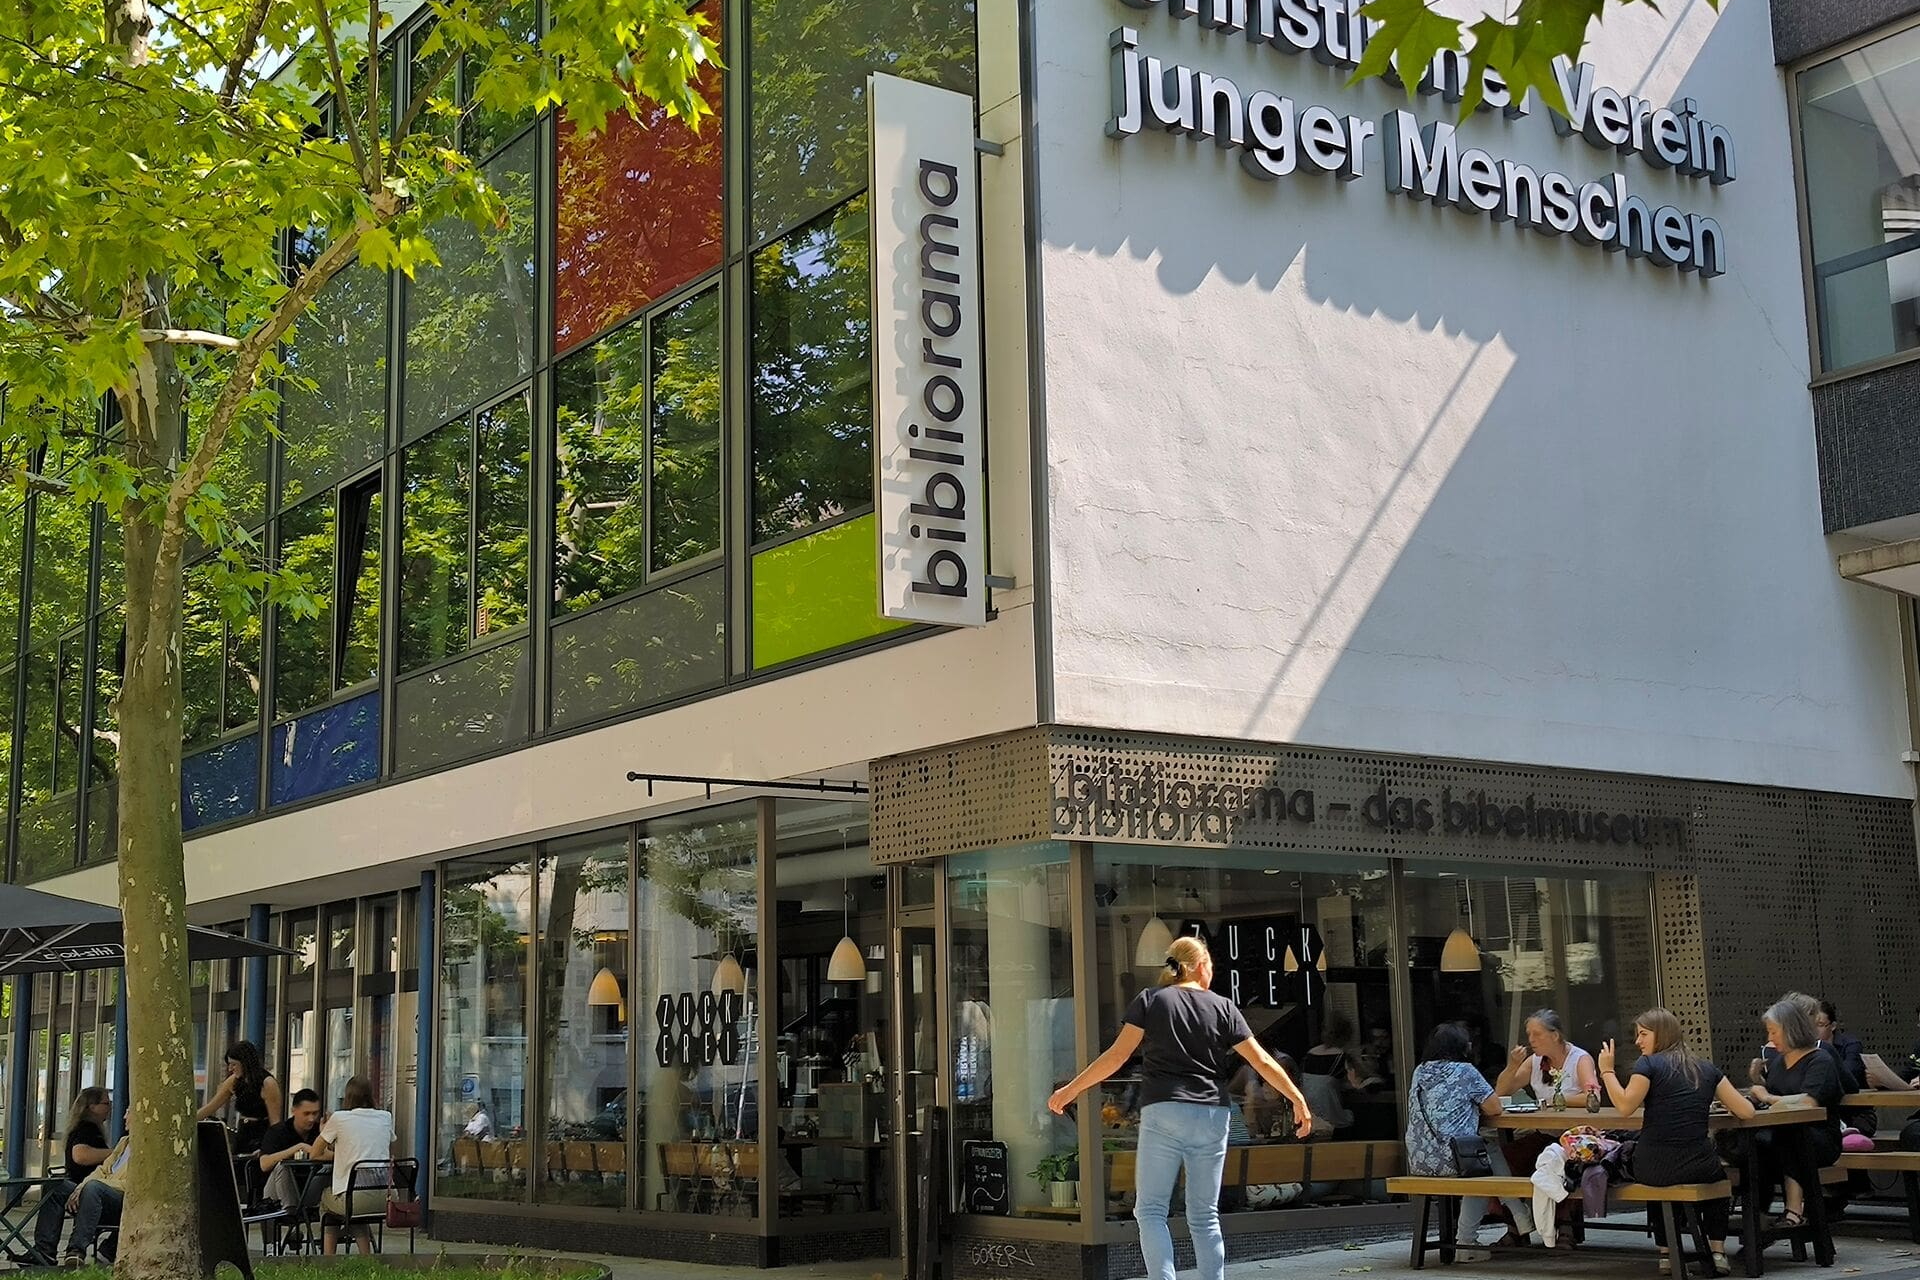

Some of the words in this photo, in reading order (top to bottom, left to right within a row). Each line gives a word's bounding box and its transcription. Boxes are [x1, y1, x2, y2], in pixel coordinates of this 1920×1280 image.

[1112, 26, 1376, 179] junger
[1388, 108, 1727, 278] Menschen
[1551, 55, 1737, 185] Verein
[909, 158, 968, 598] bibliorama
[1066, 758, 1315, 826] bibliorama
[1362, 783, 1435, 834] das
[1441, 784, 1687, 852] bibelmuseum
[663, 993, 731, 1027] ZUCK
[1231, 970, 1311, 1005] REI
[663, 1031, 731, 1064] EREI
